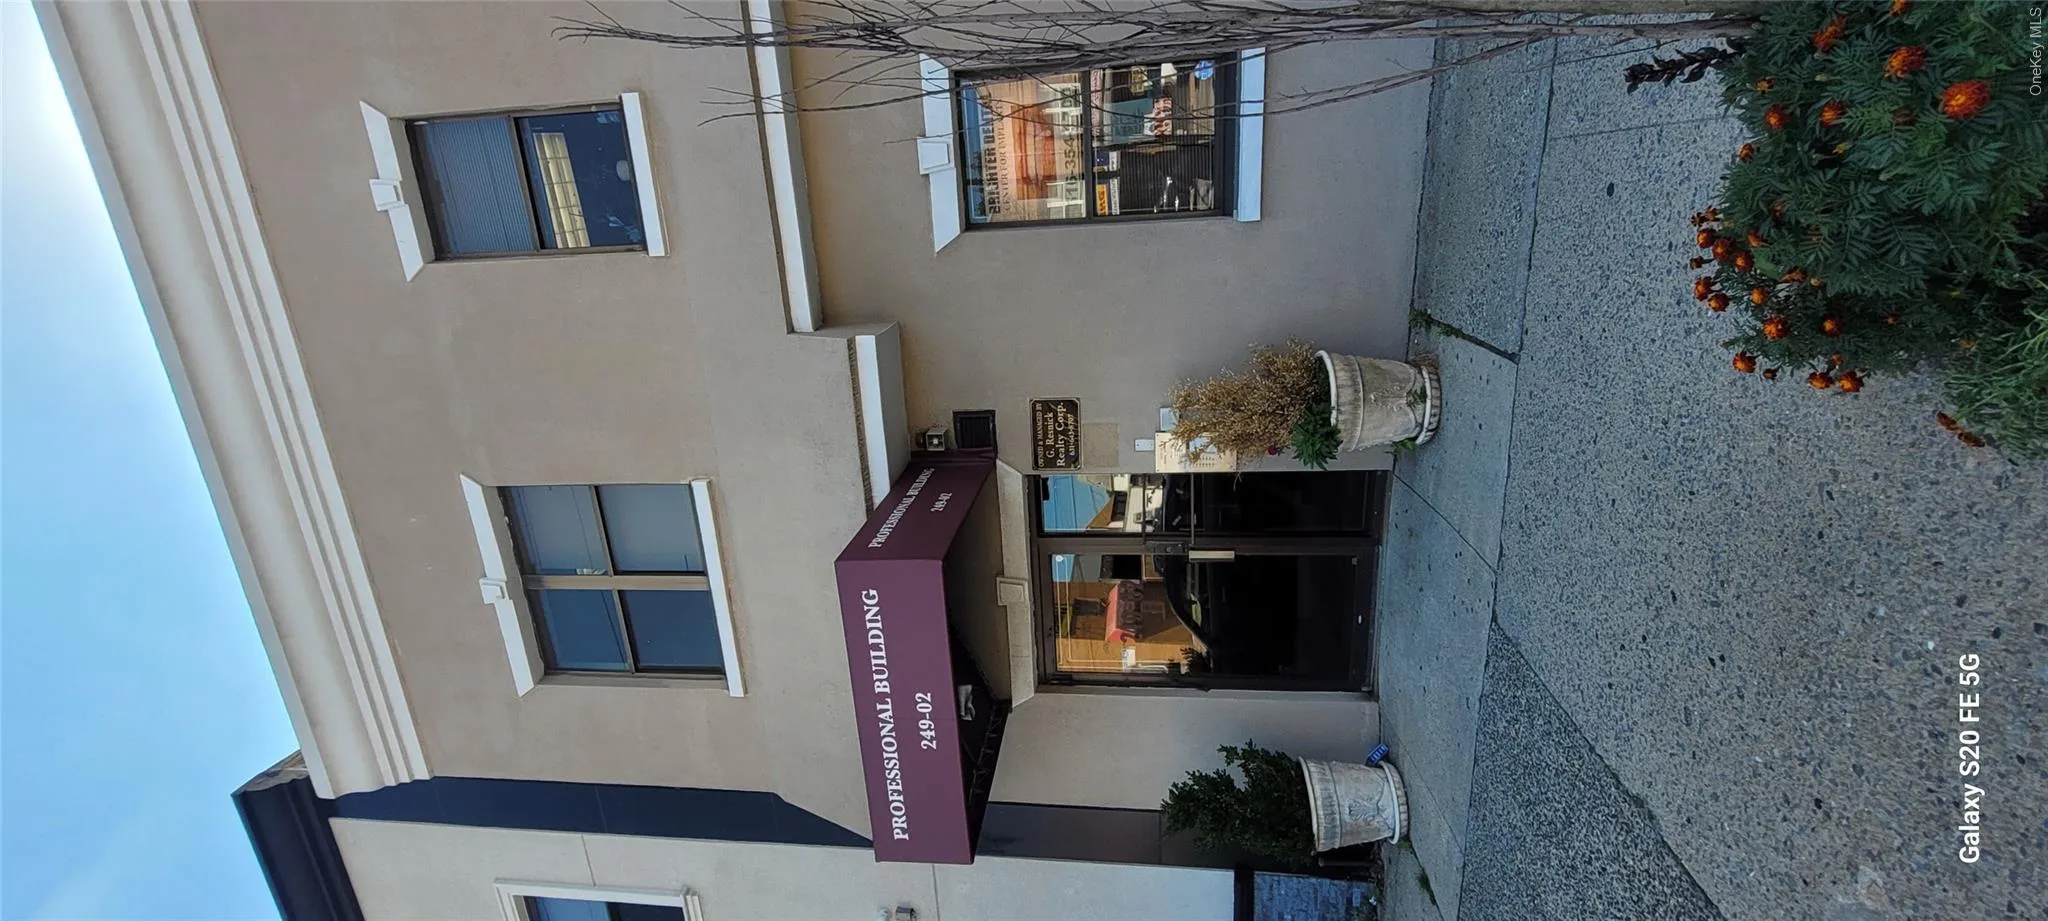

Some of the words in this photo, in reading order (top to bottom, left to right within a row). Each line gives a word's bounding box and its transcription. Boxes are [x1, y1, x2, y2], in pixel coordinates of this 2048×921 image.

[995, 99, 1006, 149] IMPLTS
[1036, 402, 1042, 411] BY
[1055, 402, 1067, 431] Corp.
[1044, 412, 1054, 445] Resnick
[1046, 448, 1055, 458] G.
[1055, 434, 1067, 466] Realty
[868, 496, 916, 548] PROFESSIONAL
[906, 468, 935, 496] BUILDING
[930, 492, 953, 512] 249-02
[861, 588, 891, 694] BUILDING
[915, 692, 937, 750] 249-02
[876, 698, 909, 841] PROFESSIONAL
